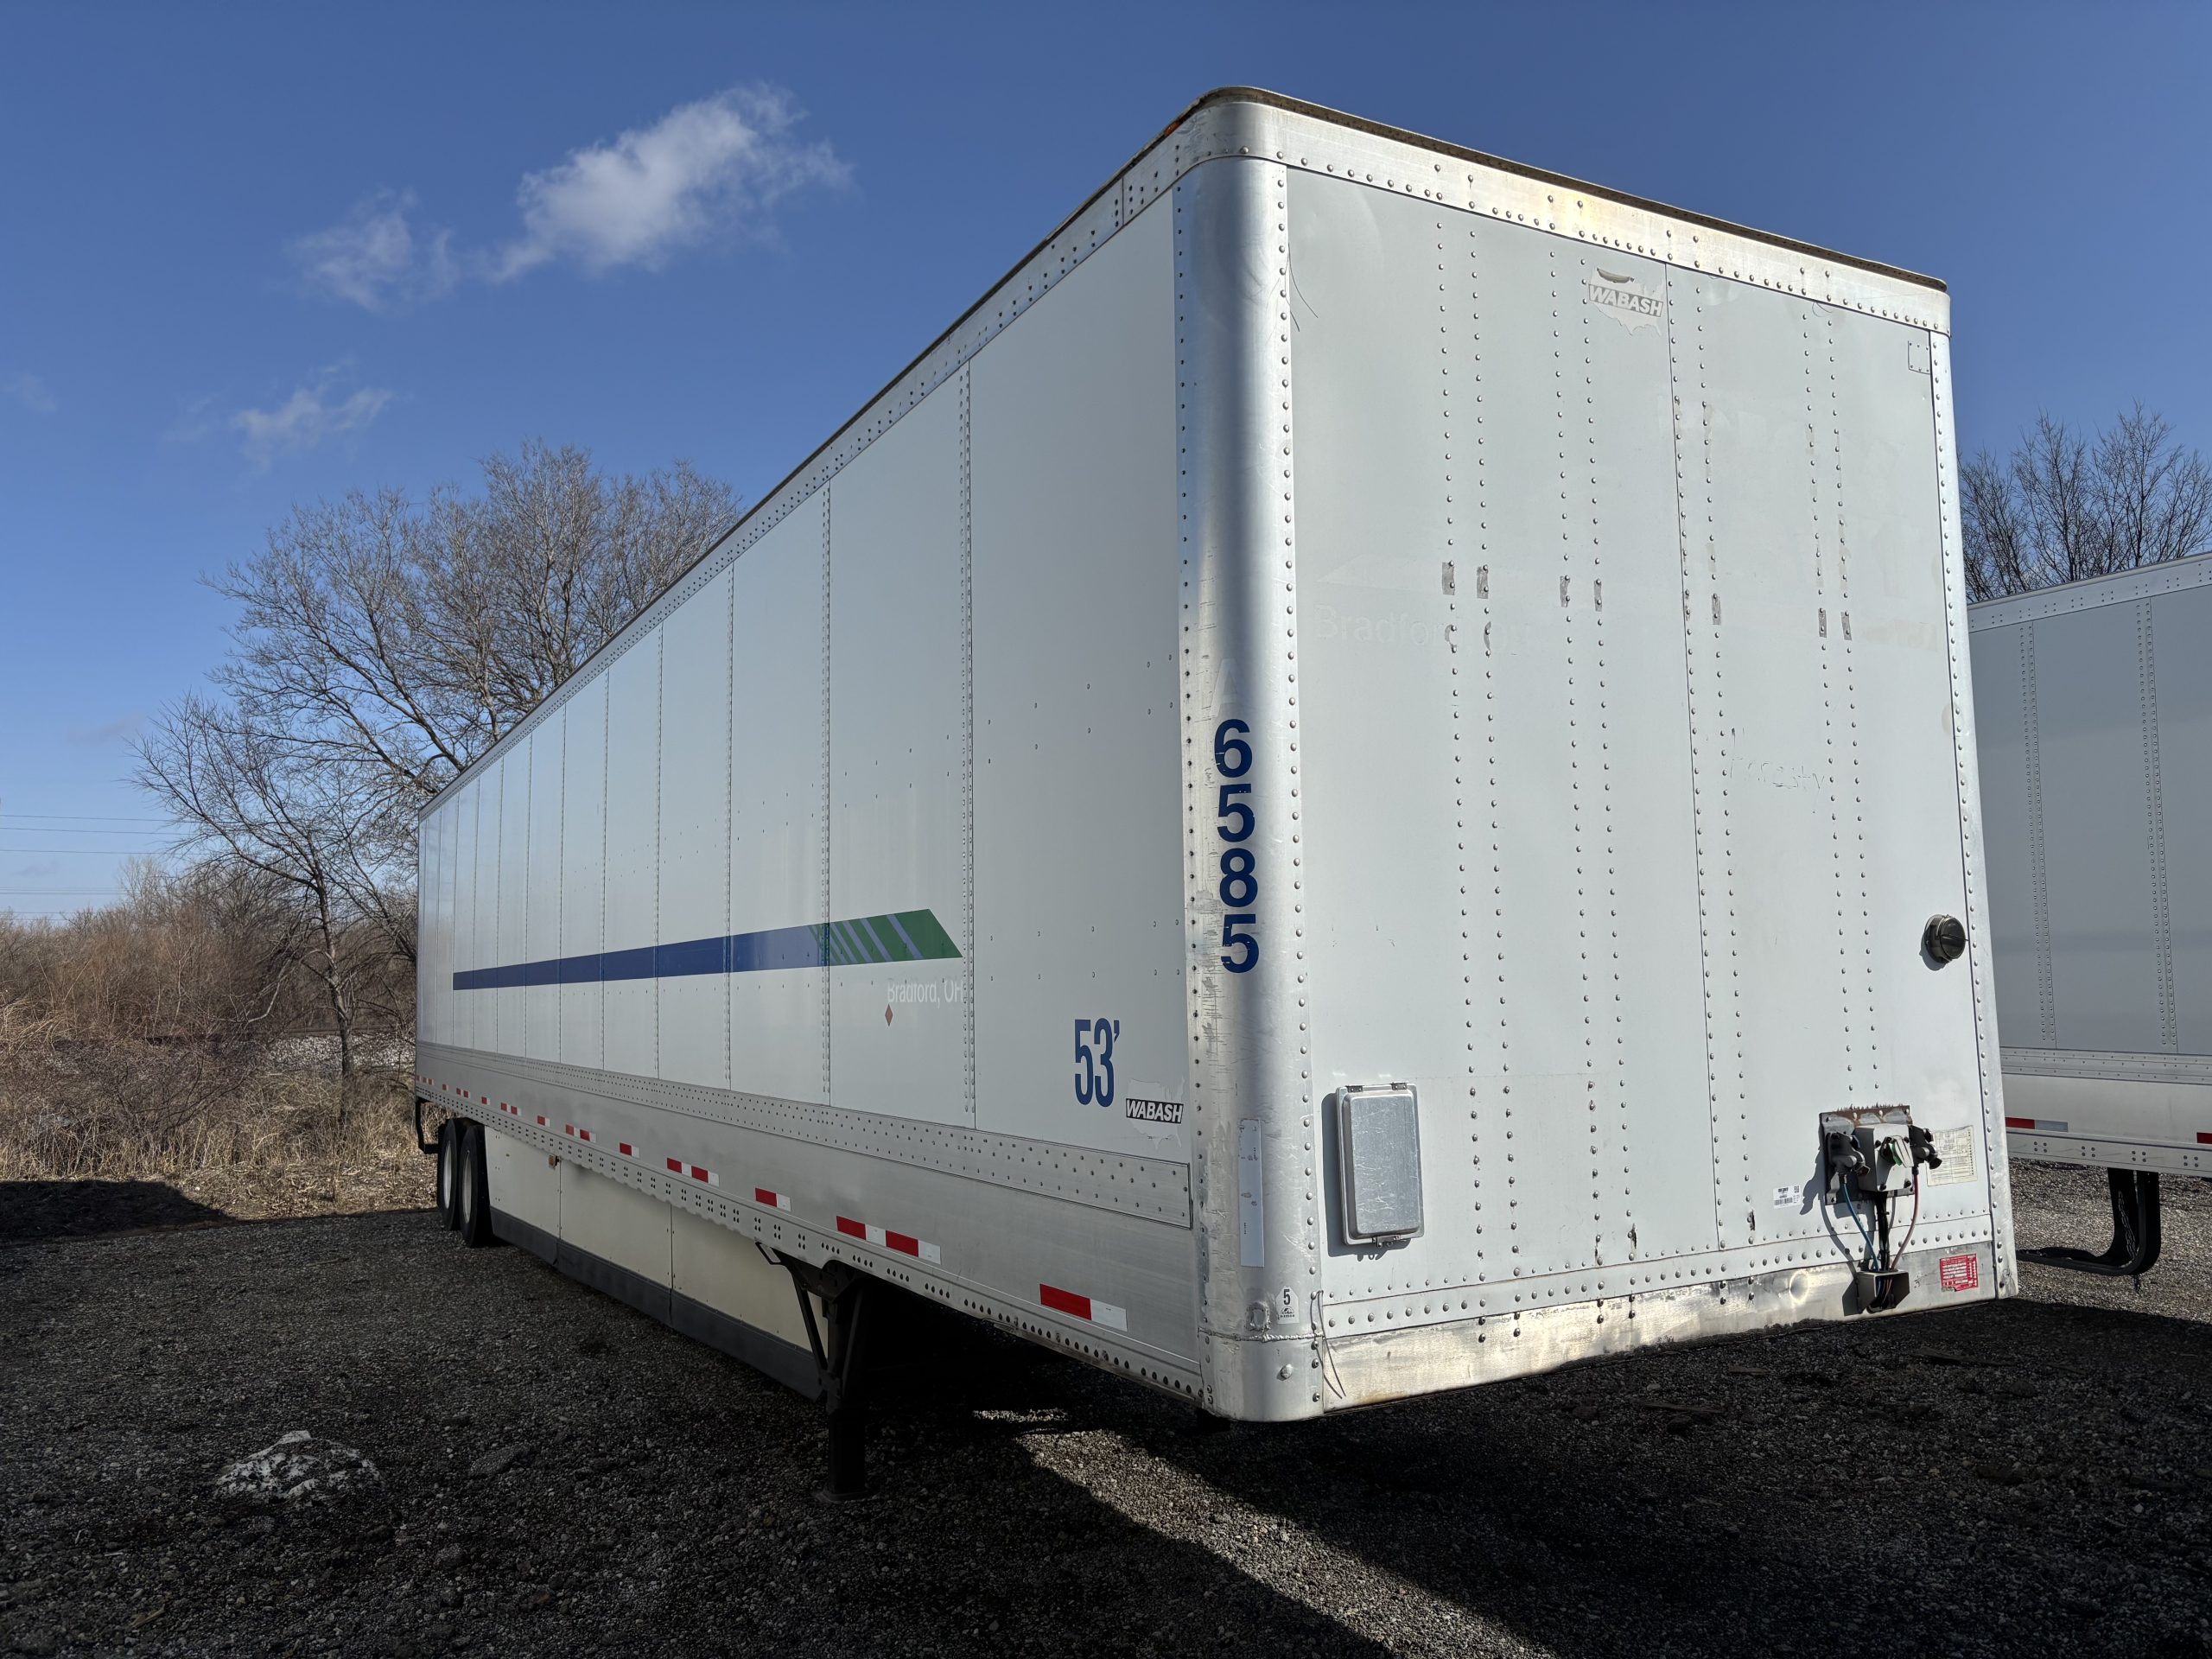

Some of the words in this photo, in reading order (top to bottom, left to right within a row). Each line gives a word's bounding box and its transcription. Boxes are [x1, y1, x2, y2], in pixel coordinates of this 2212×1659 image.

[1590, 285, 1662, 316] WABASH
[1214, 718, 1260, 974] 6585
[887, 980, 940, 1008] Bradford,
[1126, 1099, 1183, 1123] WABASH
[1283, 1288, 1291, 1306] 5
